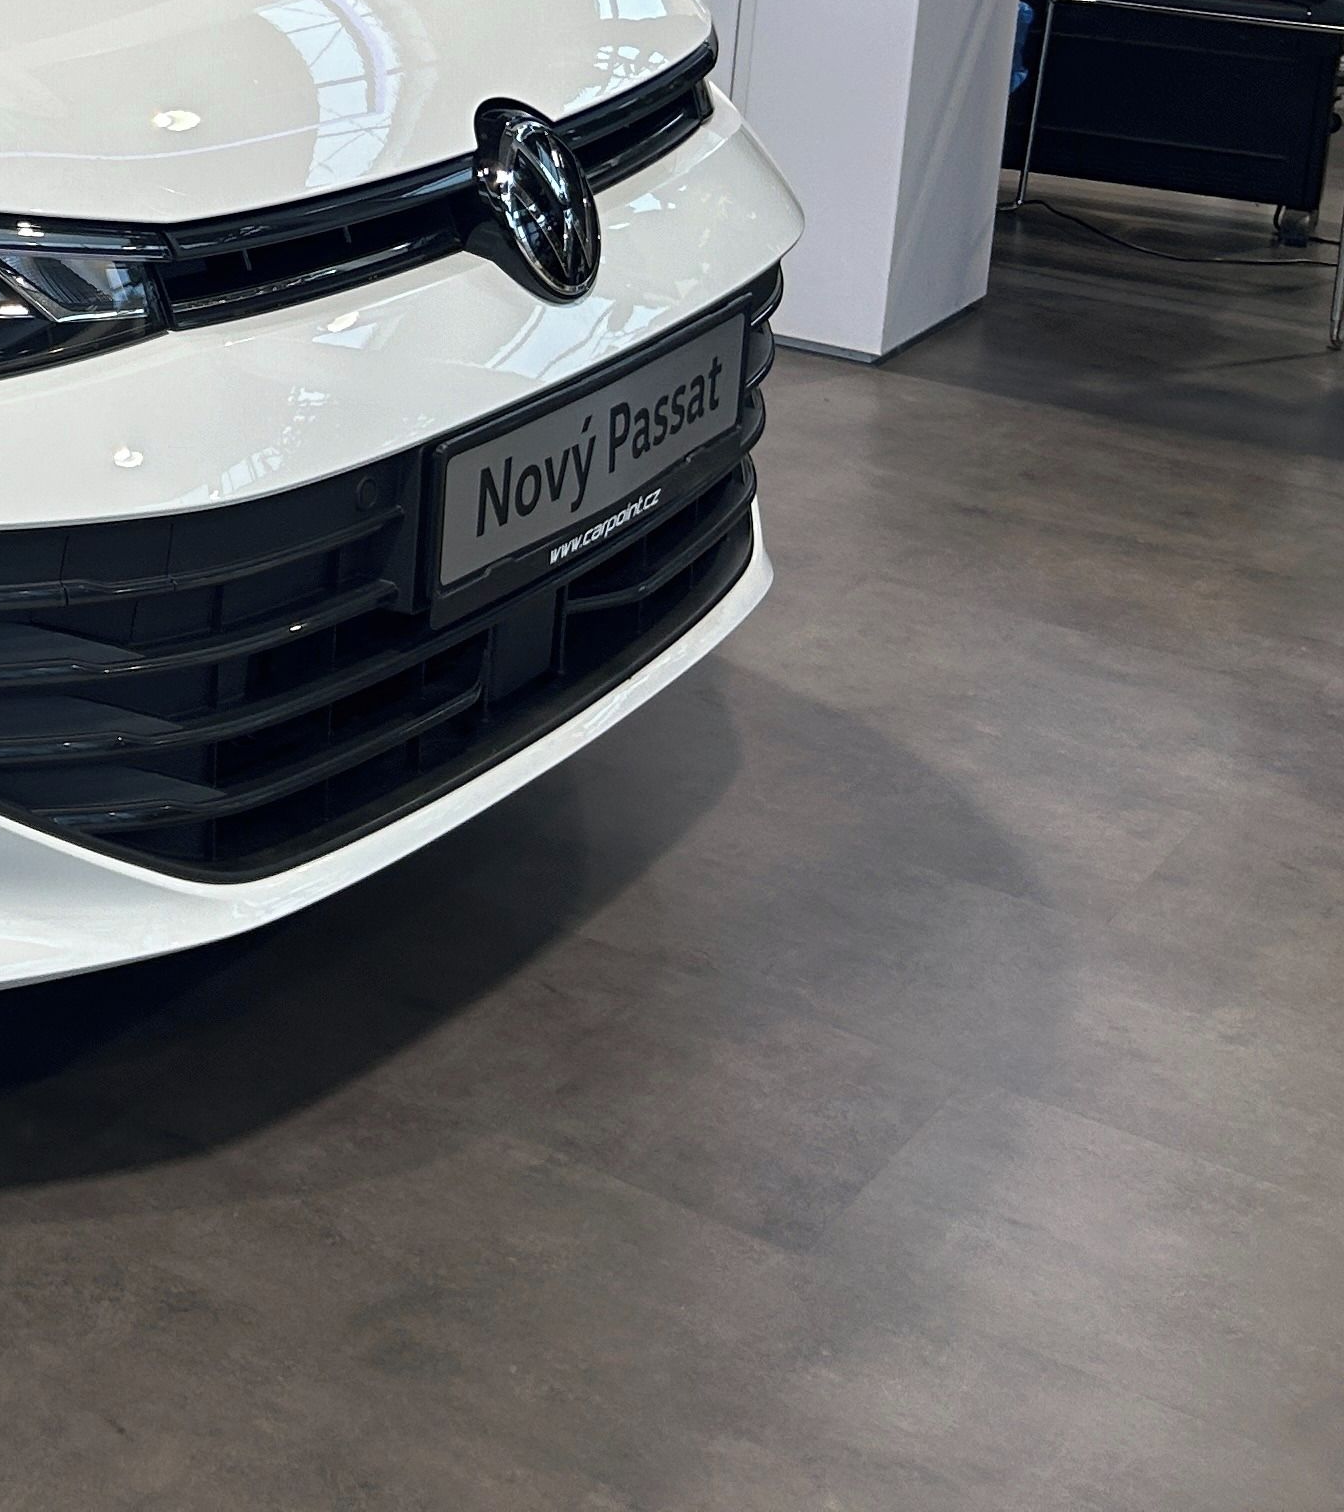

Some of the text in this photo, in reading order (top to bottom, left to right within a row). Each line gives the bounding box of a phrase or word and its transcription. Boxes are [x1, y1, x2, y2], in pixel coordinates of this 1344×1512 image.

[476, 356, 723, 538] Nový Passat
[549, 488, 662, 565] www.carpoint.cz
